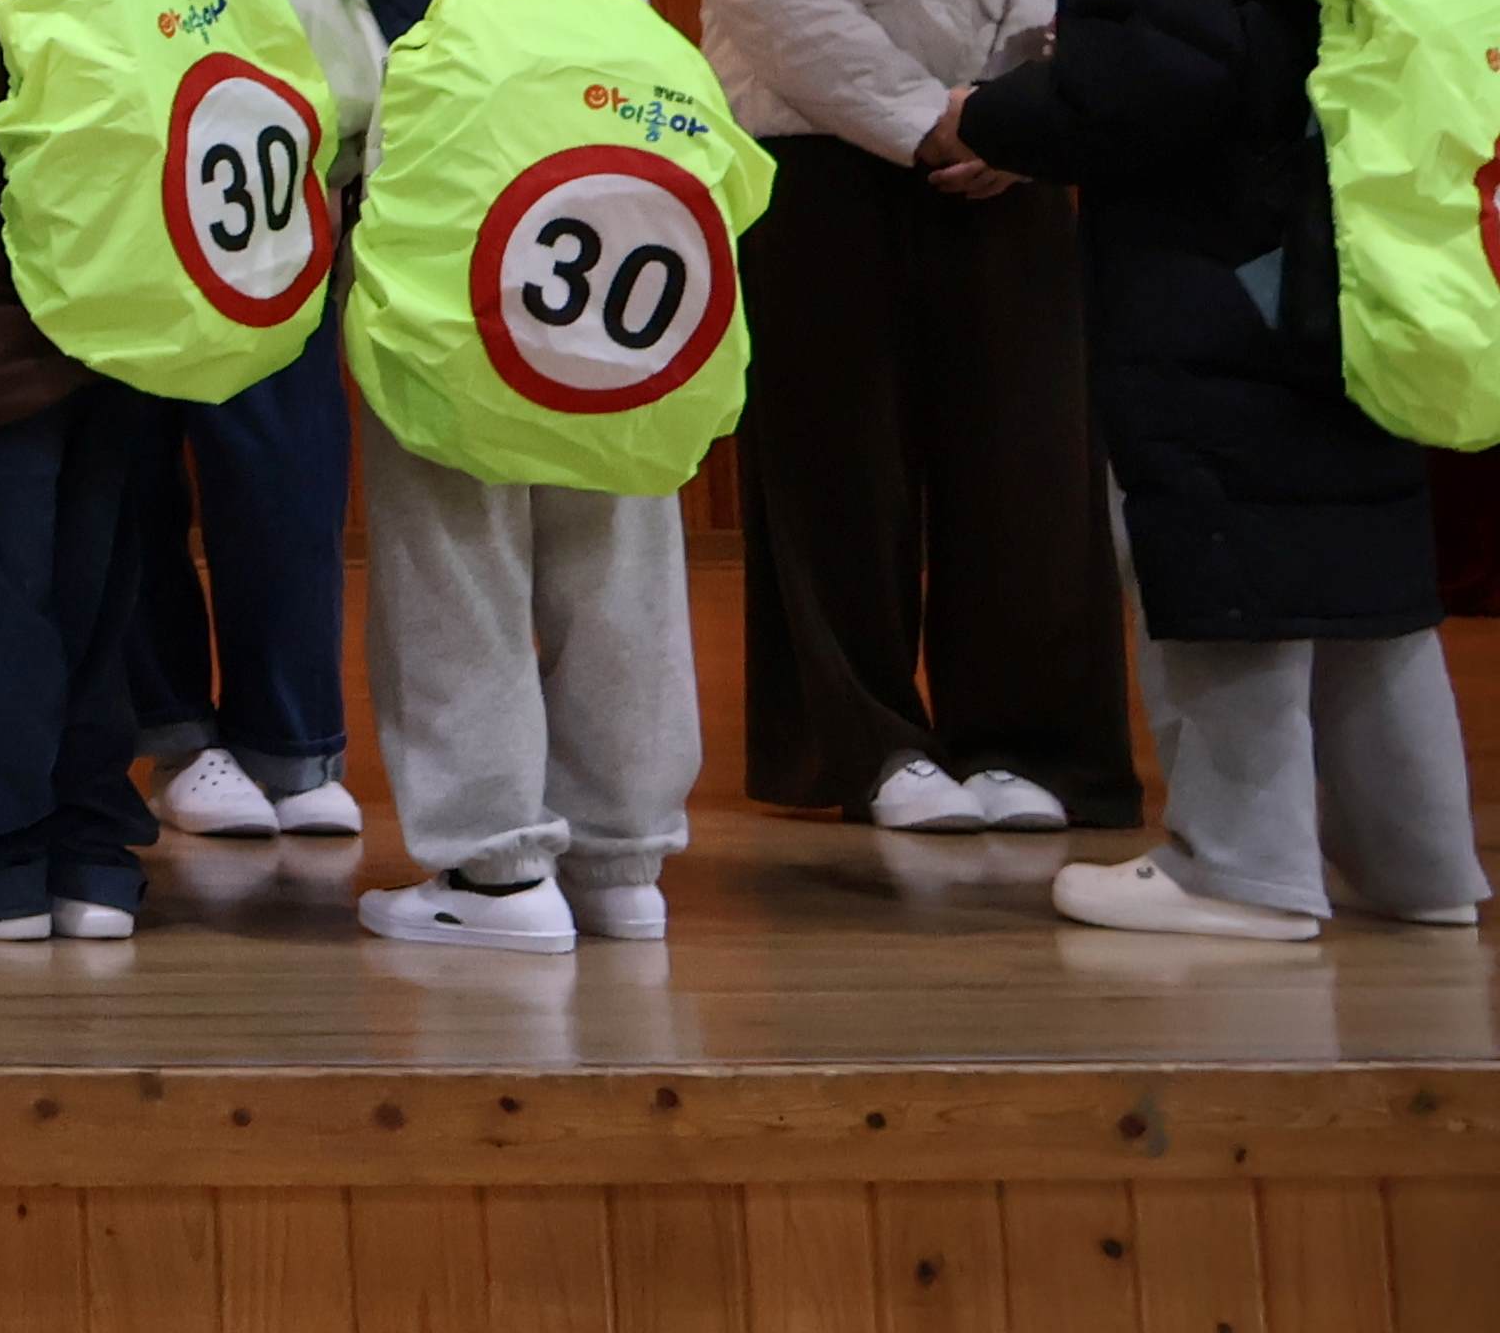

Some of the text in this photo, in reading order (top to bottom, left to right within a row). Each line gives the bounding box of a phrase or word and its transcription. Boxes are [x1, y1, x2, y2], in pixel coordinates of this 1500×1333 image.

[583, 83, 709, 142] 아이좋아
[200, 124, 299, 253] 30
[521, 216, 688, 350] 30
